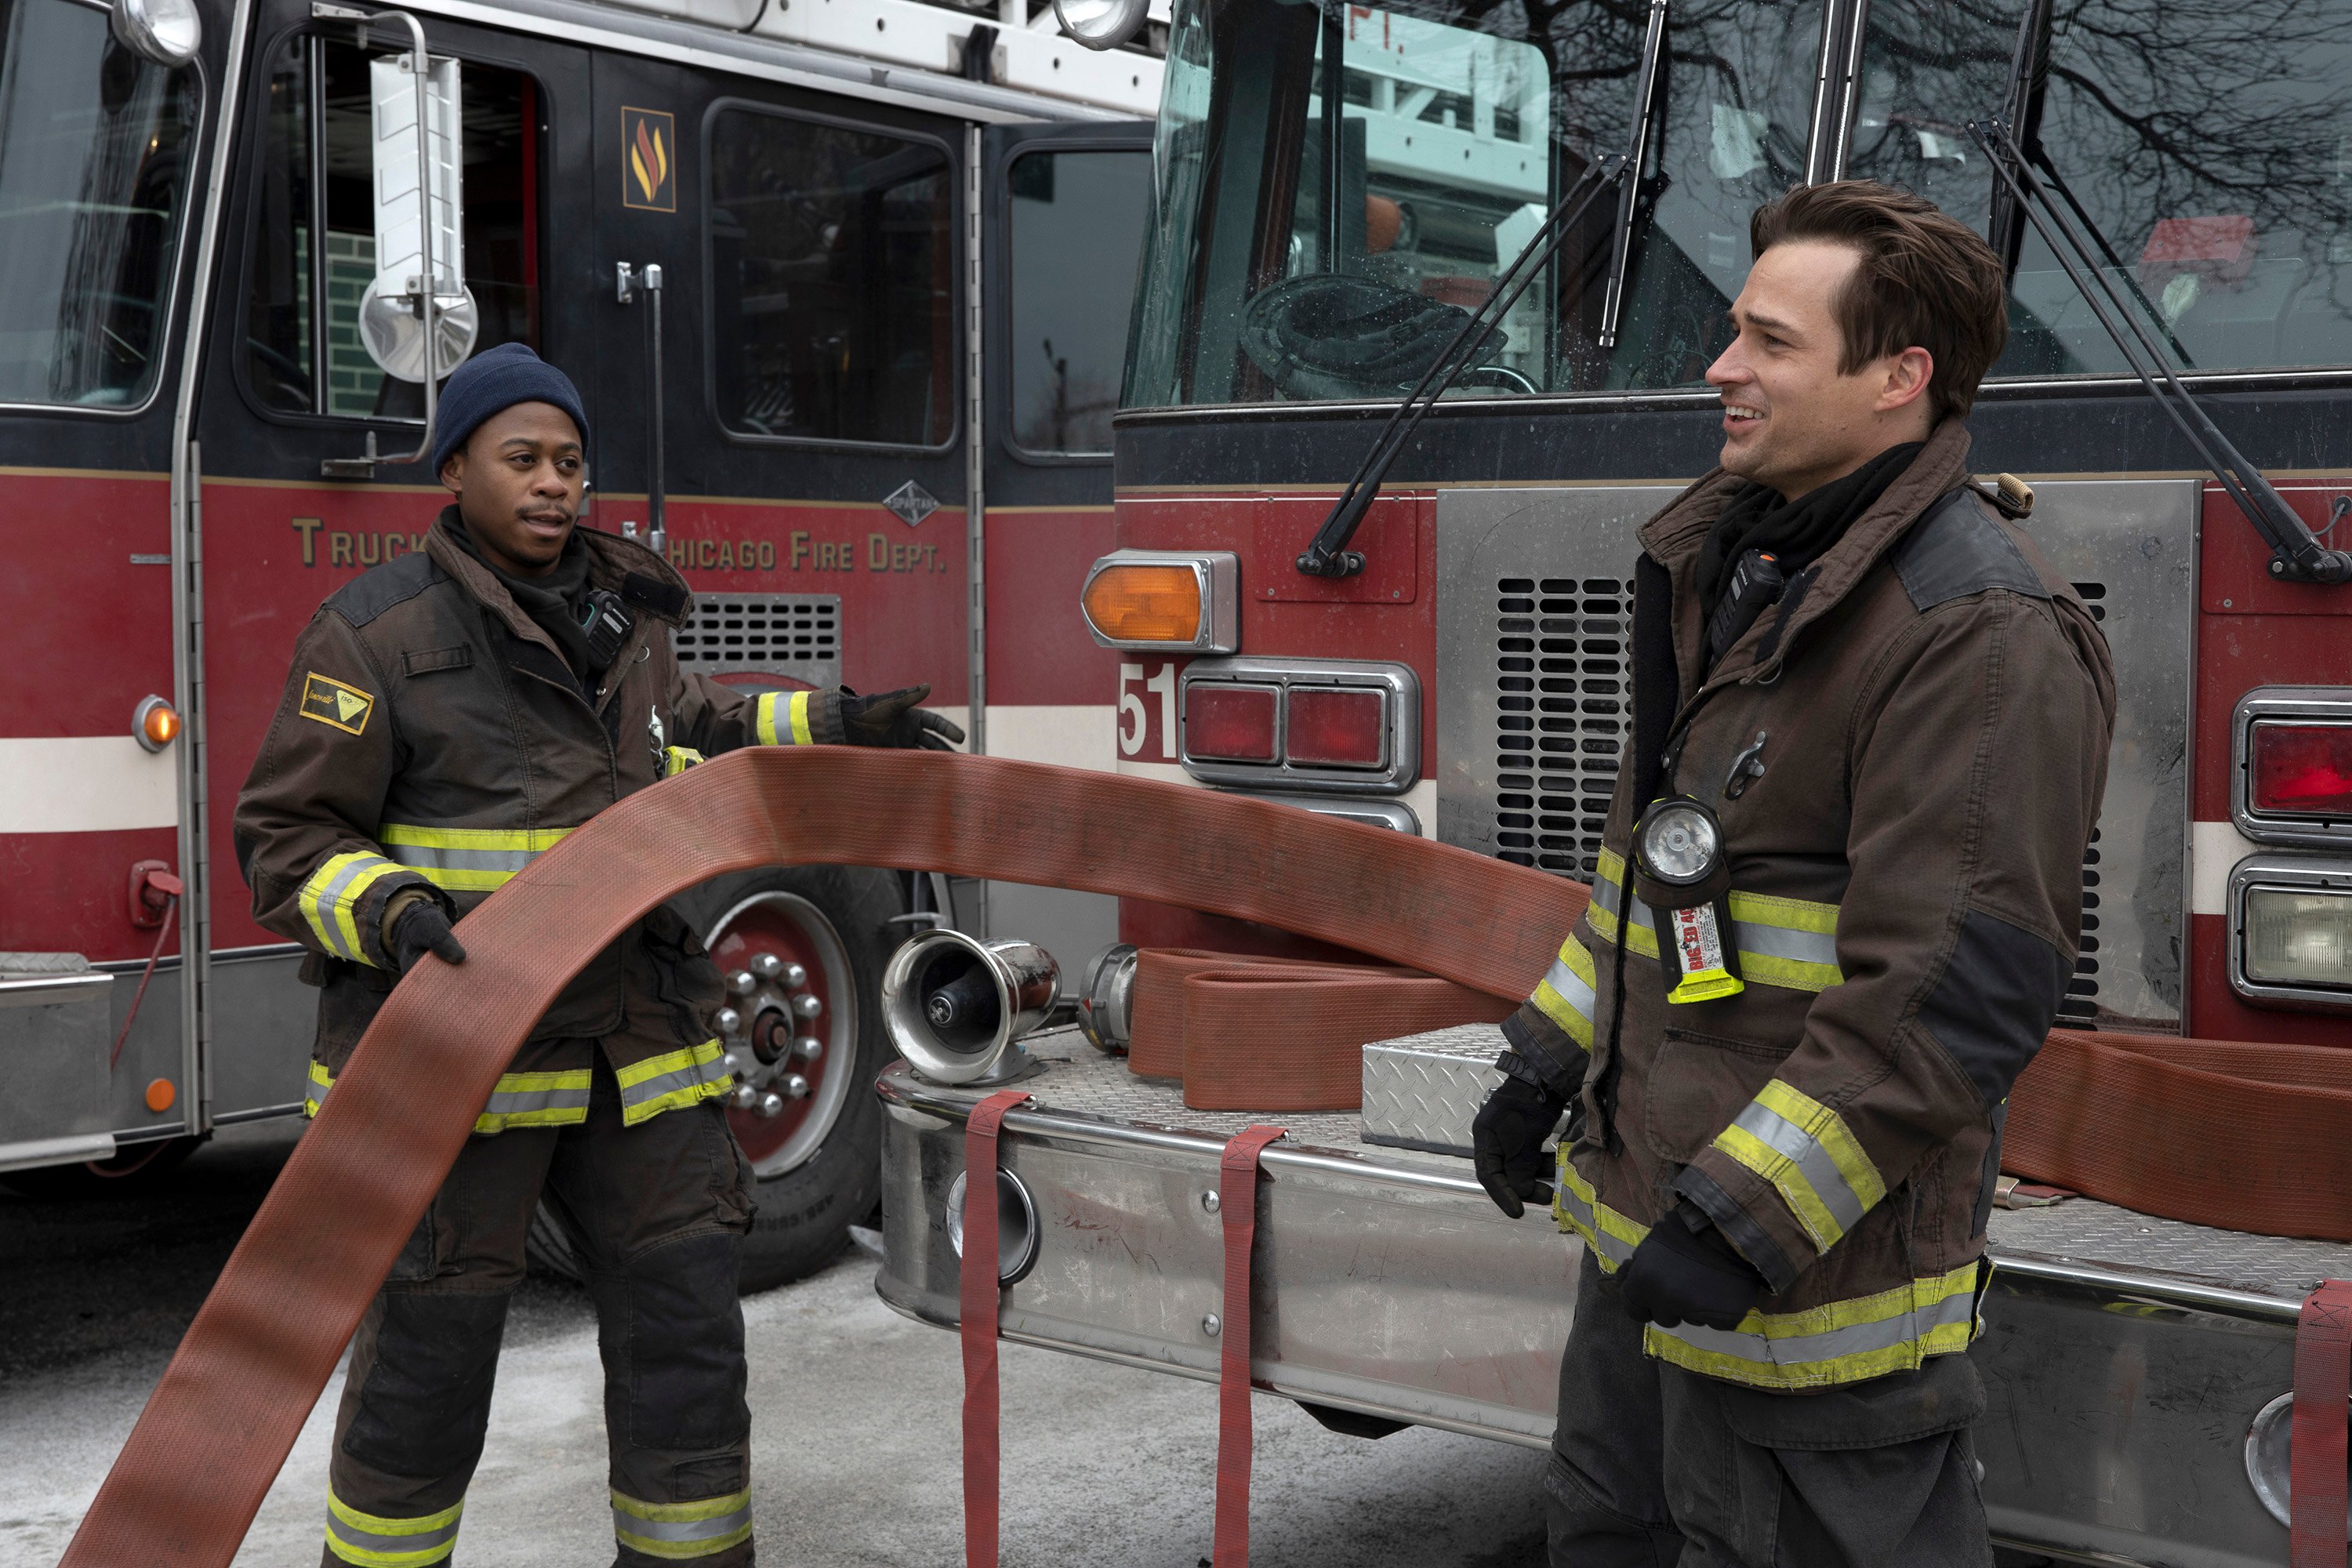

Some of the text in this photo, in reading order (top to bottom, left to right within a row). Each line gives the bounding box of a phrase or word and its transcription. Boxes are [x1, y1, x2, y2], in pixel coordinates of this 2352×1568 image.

[640, 527, 947, 574] HICAGO FIRE DEPT.
[1119, 662, 1177, 759] 51
[1686, 946, 1704, 971] BIG
